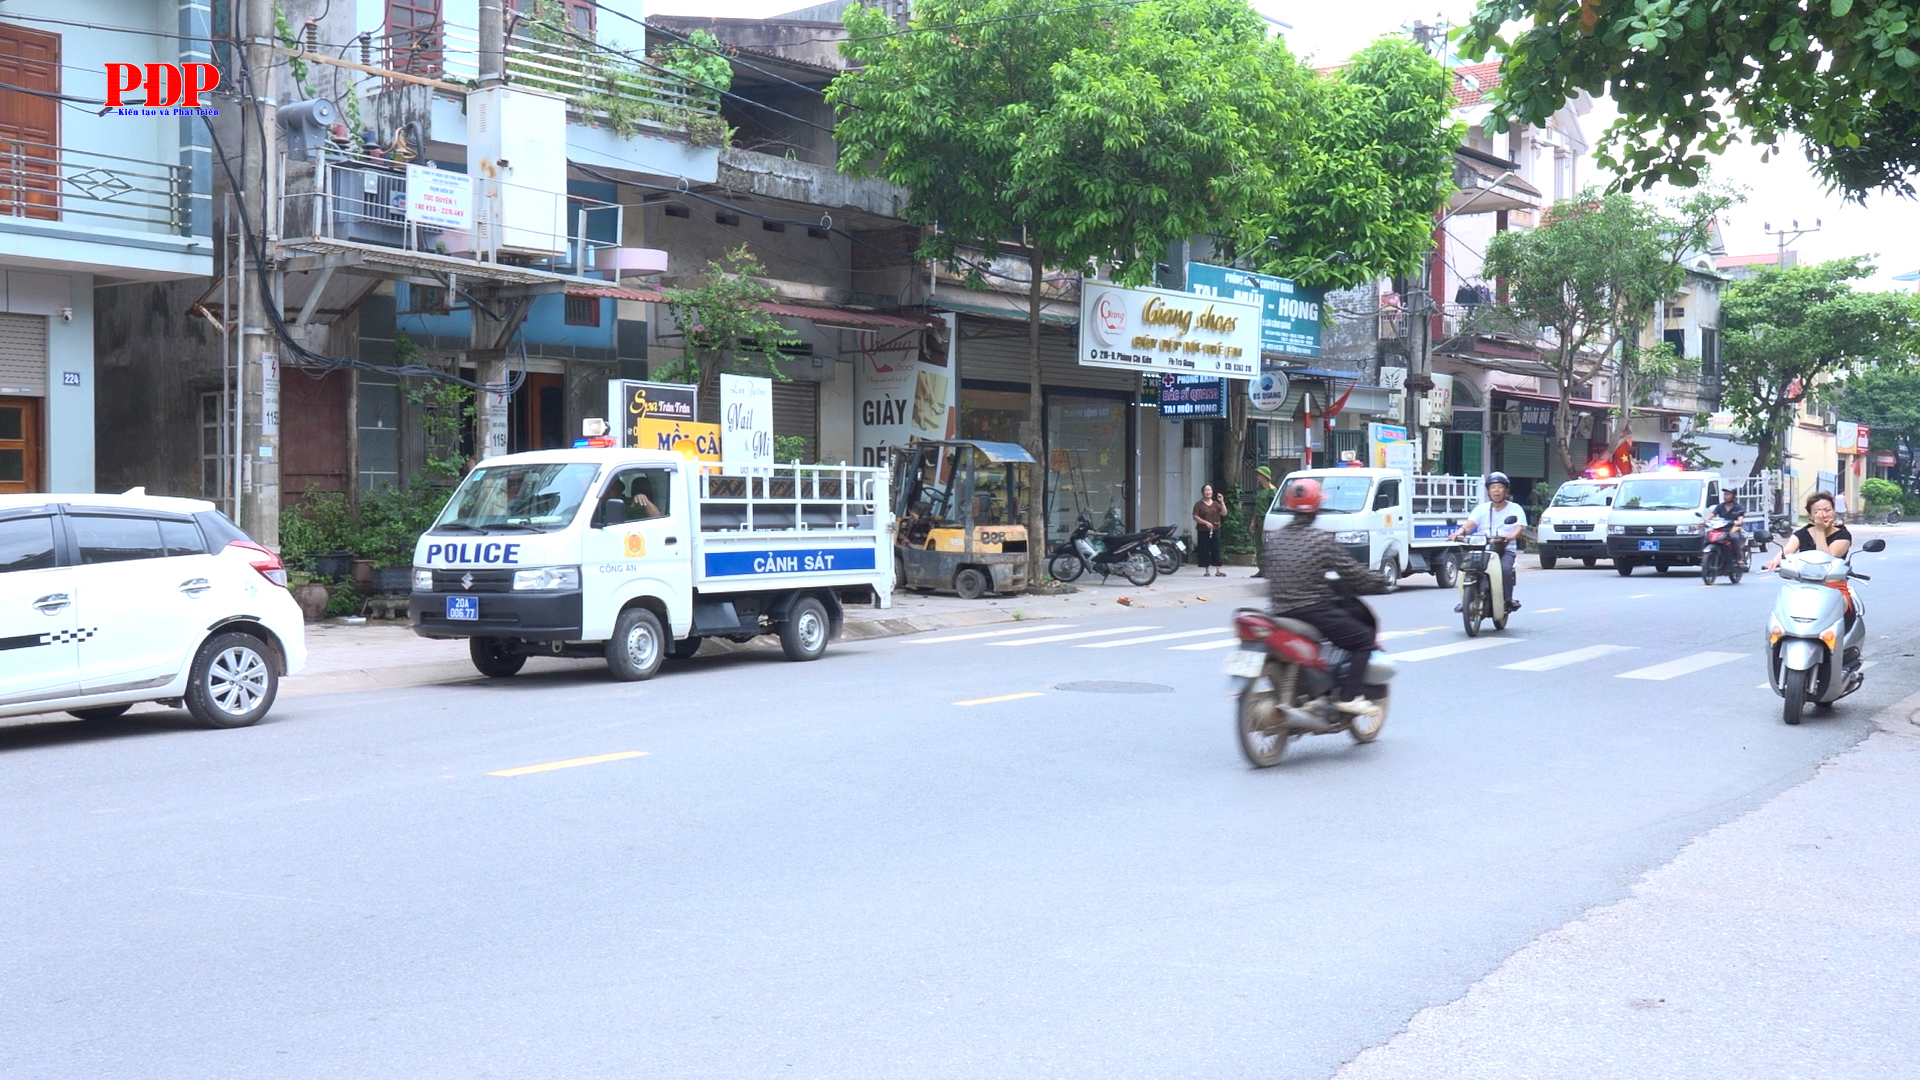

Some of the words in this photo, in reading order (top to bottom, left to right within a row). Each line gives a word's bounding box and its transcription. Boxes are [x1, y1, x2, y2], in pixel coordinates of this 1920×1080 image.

[1142, 297, 1193, 336] Giang
[1197, 304, 1238, 333] shoes
[1278, 297, 1319, 322] HỌNG
[630, 389, 658, 418] Spa
[1163, 387, 1179, 401] BÁC
[1190, 388, 1219, 402] QUANG
[727, 402, 753, 432] Nail
[862, 393, 907, 426] GIÀY
[1164, 405, 1176, 414] TAI
[1194, 404, 1218, 415] HỌNG
[696, 431, 722, 455] CÂ
[863, 440, 891, 468] DÉ
[426, 543, 521, 564] POLICE
[753, 551, 798, 573] CẢNH
[804, 550, 835, 570] SÁT
[599, 563, 624, 573] CÔNG
[626, 564, 637, 572] AN
[450, 608, 475, 618] 006.77
[455, 598, 469, 608] 20A
